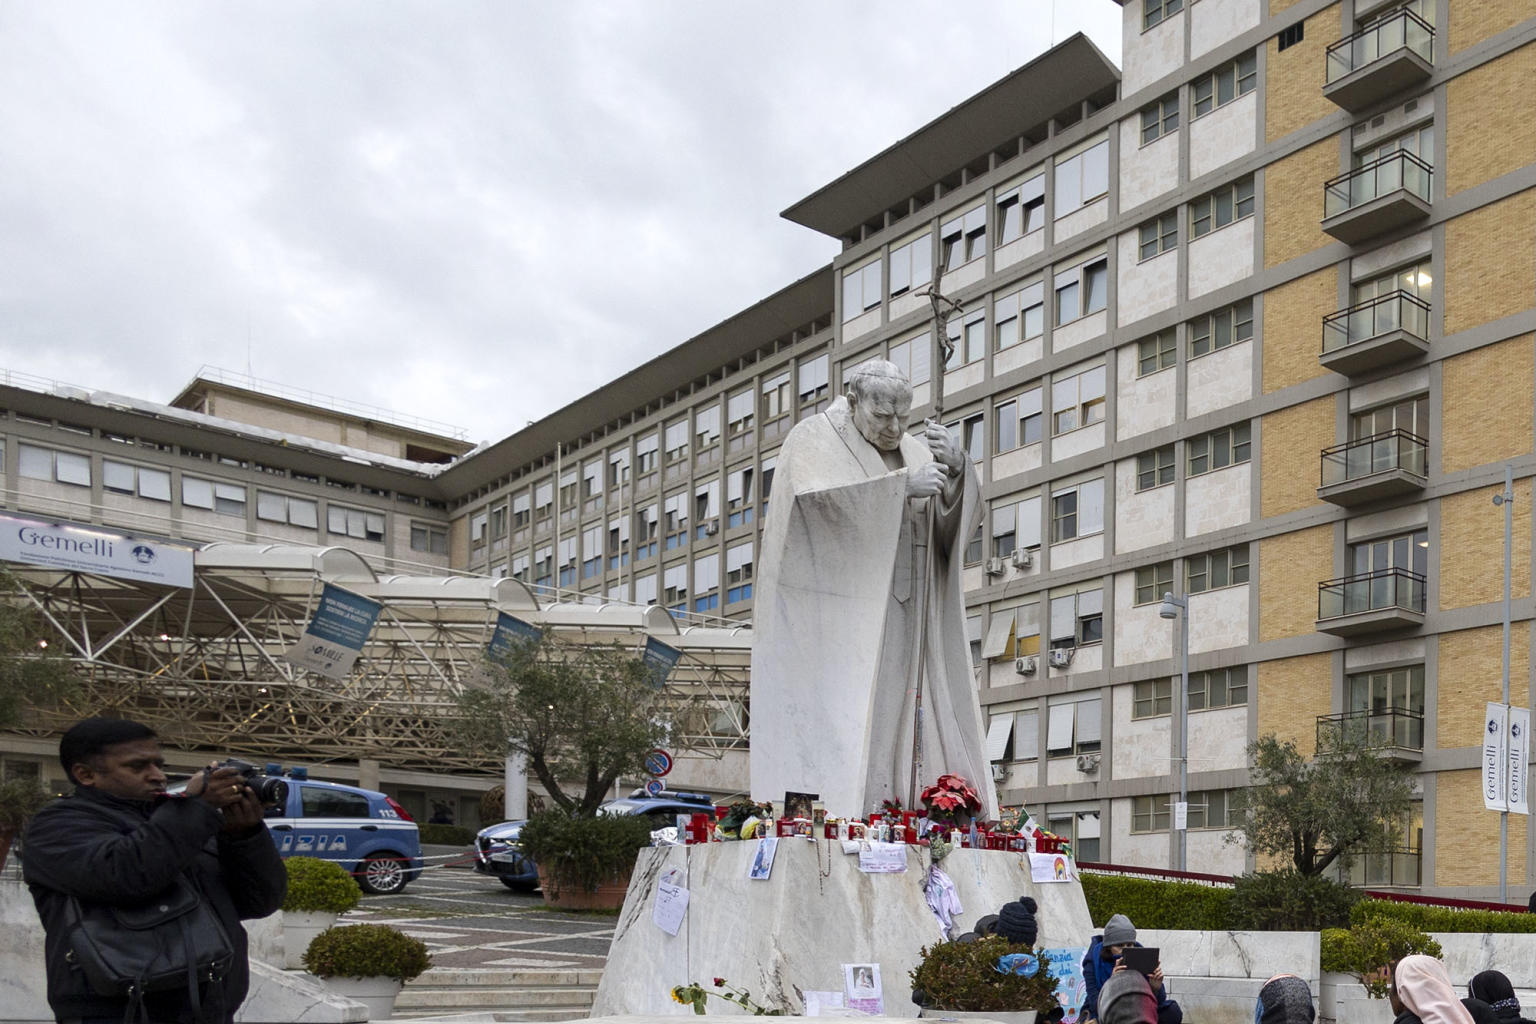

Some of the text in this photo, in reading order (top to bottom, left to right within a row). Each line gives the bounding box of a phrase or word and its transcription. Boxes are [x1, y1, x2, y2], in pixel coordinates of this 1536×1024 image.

[19, 527, 113, 558] Gemelli
[1486, 745, 1496, 800] Gemelli
[1510, 749, 1519, 803] Gemelli
[379, 809, 398, 818] 113
[281, 834, 348, 852] IZIA
